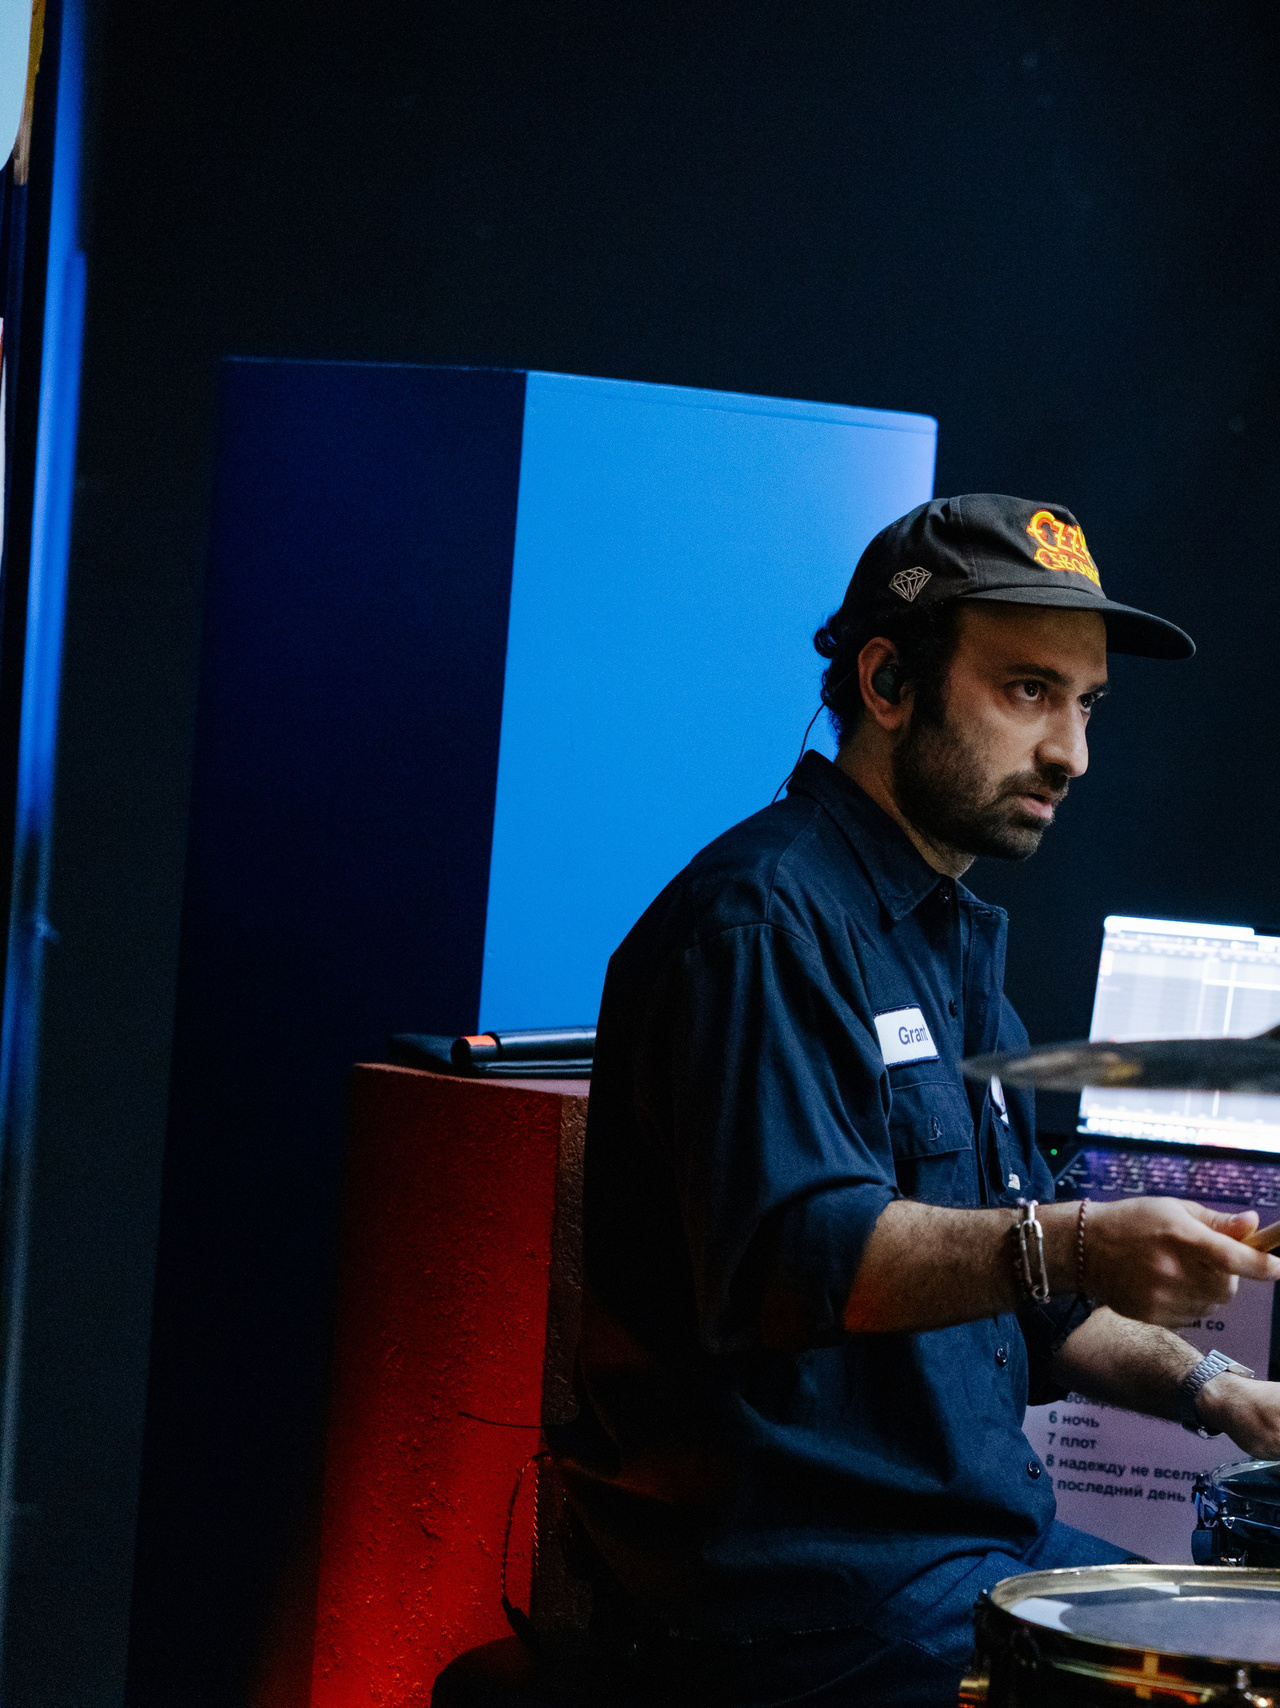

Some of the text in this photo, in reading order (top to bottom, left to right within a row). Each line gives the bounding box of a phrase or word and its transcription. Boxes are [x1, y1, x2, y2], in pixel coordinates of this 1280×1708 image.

[898, 1024, 929, 1046] Grant
[1206, 1320, 1225, 1331] со
[1049, 1410, 1100, 1428] 6 ночь
[1048, 1432, 1097, 1449] 7 плот
[1046, 1453, 1055, 1467] 8
[1059, 1459, 1126, 1478] надежду
[1131, 1465, 1149, 1477] не
[1057, 1479, 1143, 1498] последний
[1147, 1488, 1186, 1502] день
